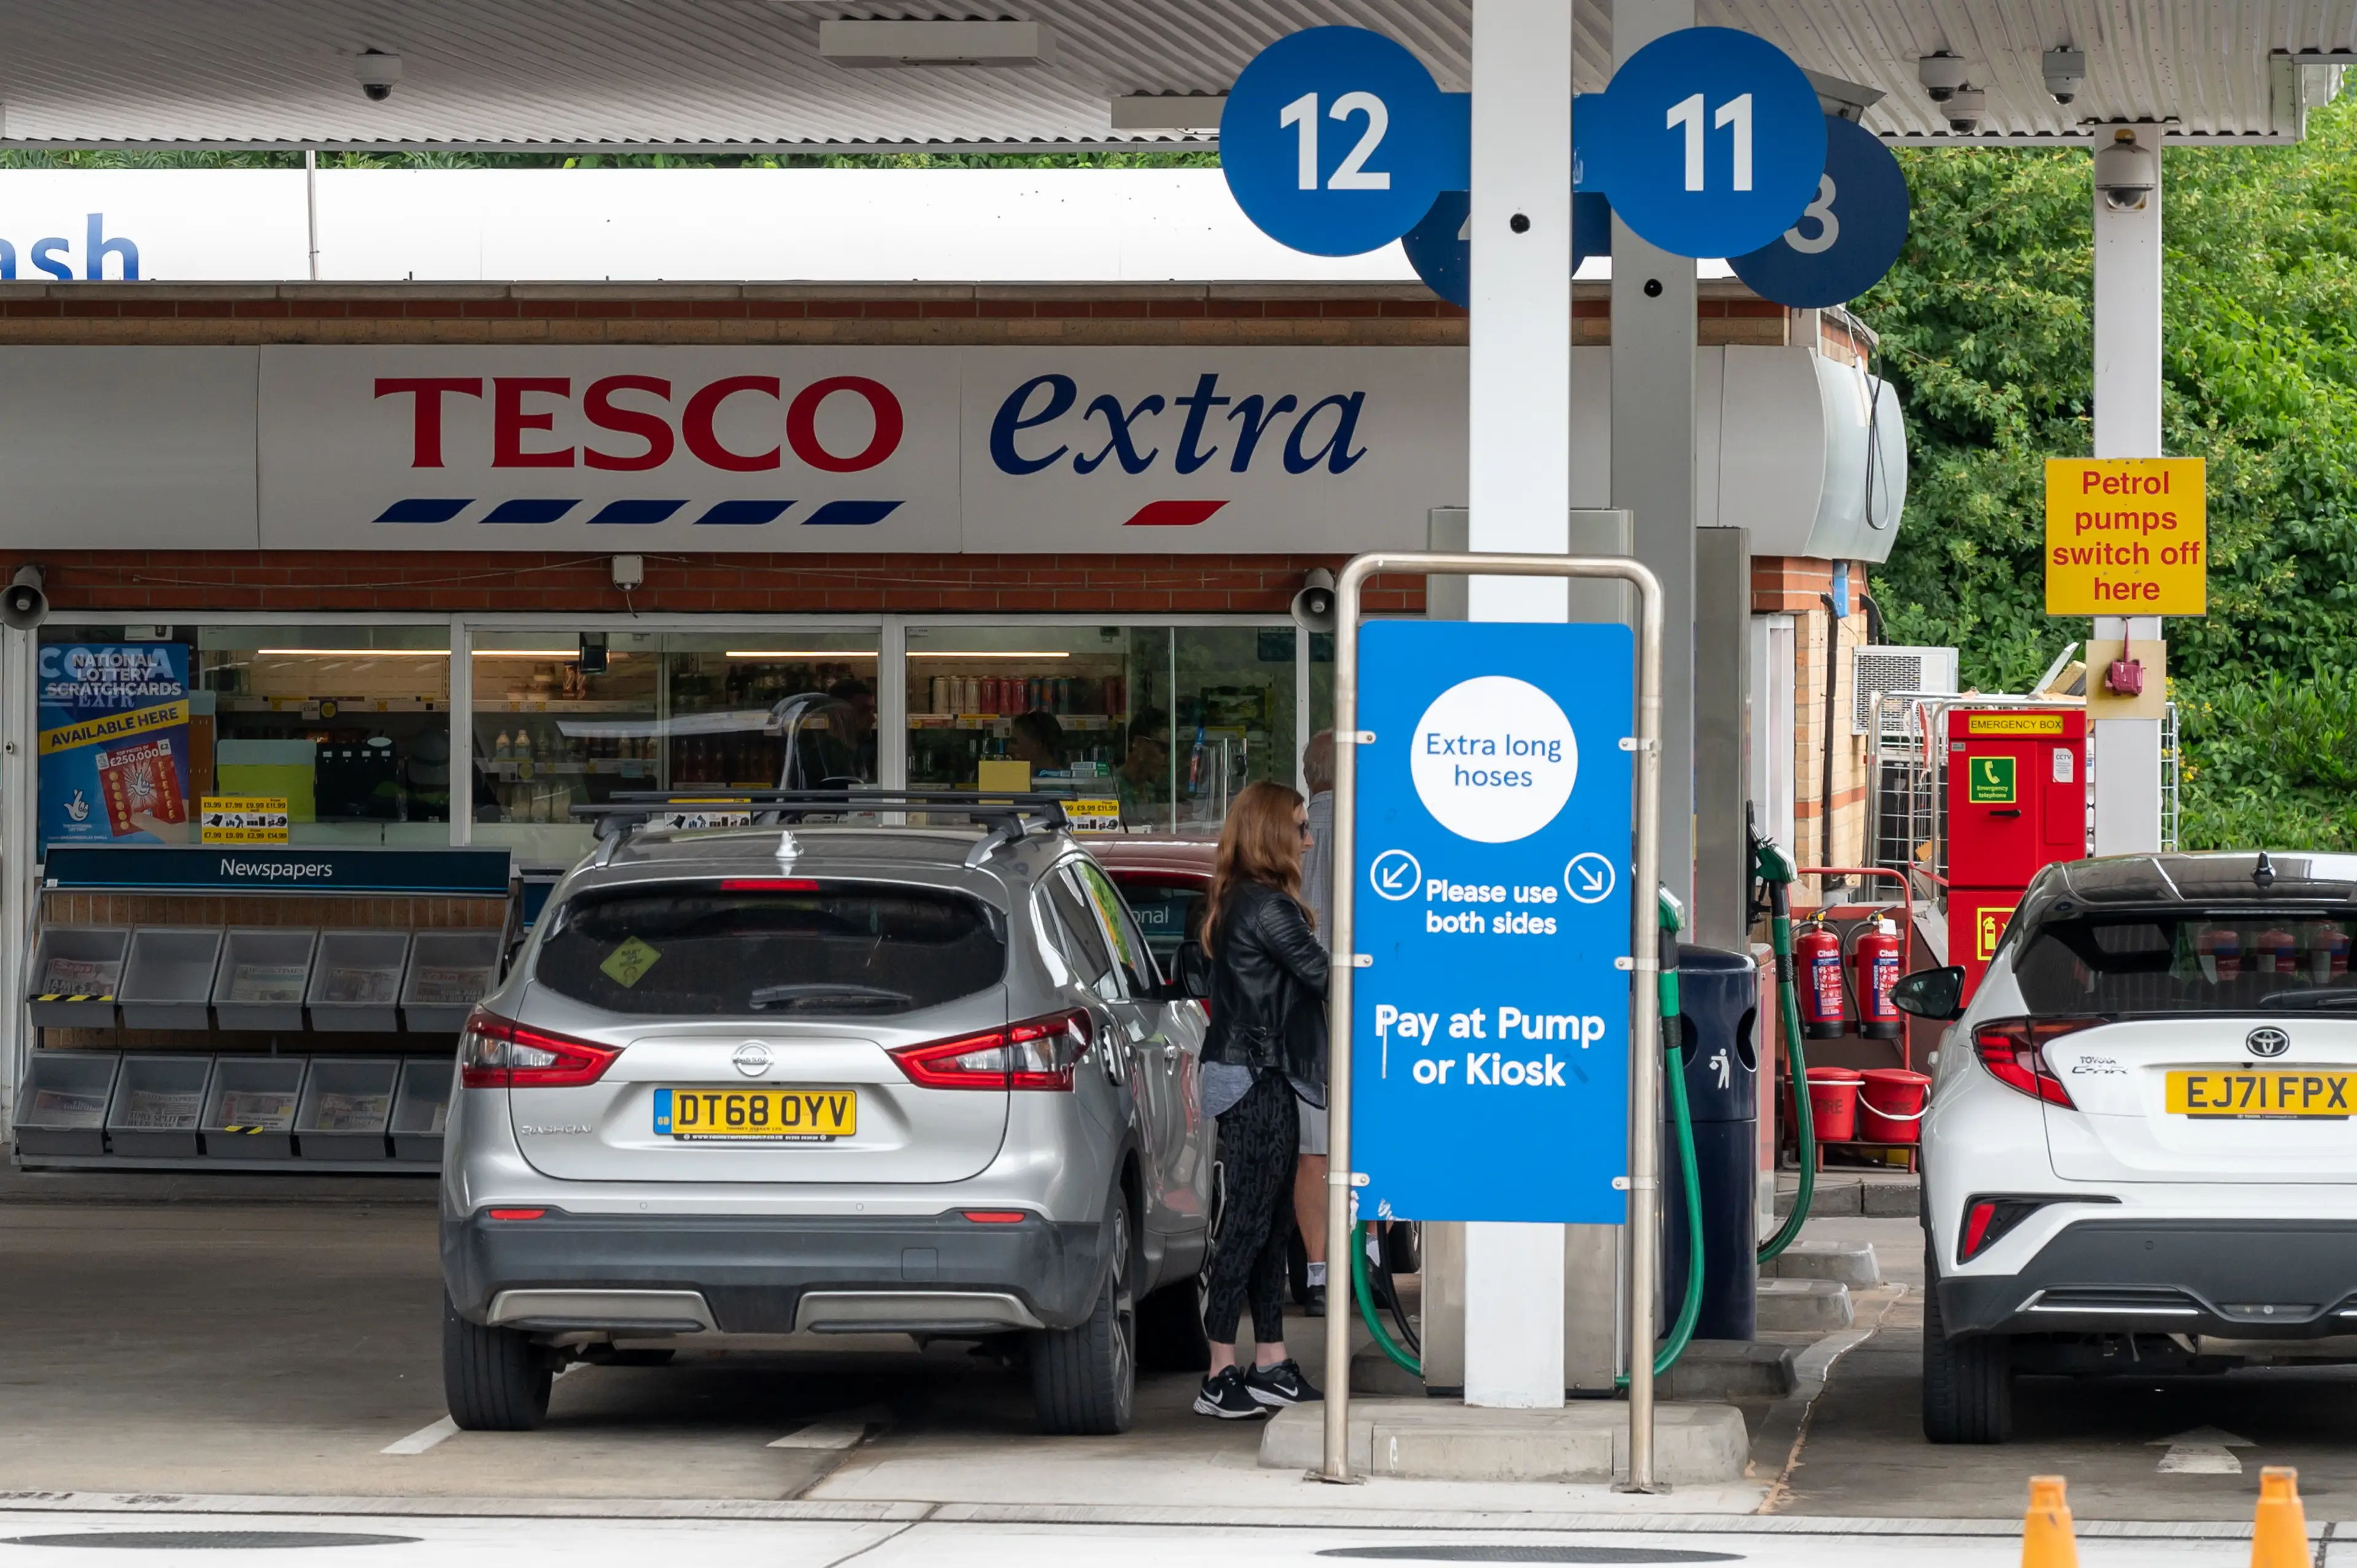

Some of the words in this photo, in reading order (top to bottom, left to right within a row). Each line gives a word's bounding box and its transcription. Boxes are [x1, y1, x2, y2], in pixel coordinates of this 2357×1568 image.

[1280, 91, 1391, 191] 12
[1666, 93, 1754, 191] 11
[1783, 173, 1839, 253] 3
[374, 374, 904, 473] TESCO
[989, 373, 1368, 475] extra
[2083, 471, 2169, 495] Petrol
[2075, 511, 2178, 536] pumps
[2053, 541, 2150, 565] switch
[2160, 541, 2200, 565] off
[2094, 577, 2160, 600] here
[72, 653, 158, 667] NATIONAL
[77, 668, 153, 682] LOTTERY
[47, 682, 182, 696] SCRATCHCARDS
[51, 716, 136, 747] AVAILABLE
[137, 707, 179, 727] HERE
[1970, 720, 2037, 729] EMERGENCY
[2040, 720, 2062, 729] BOX
[1426, 733, 1496, 755] Extra
[1506, 734, 1562, 763] long
[1455, 765, 1533, 787] hoses
[220, 859, 333, 879] Newspapers
[1426, 879, 1506, 903] Please
[1513, 886, 1558, 904] use
[1426, 910, 1485, 933] both
[1492, 911, 1557, 935] sides
[1375, 1004, 1439, 1046] Pay
[1449, 1007, 1486, 1038] at
[1498, 1006, 1606, 1049] Pump
[1412, 1058, 1456, 1085] or
[1466, 1052, 1566, 1087] Kiosk
[2080, 1056, 2116, 1064] TOYOTA
[2187, 1076, 2267, 1108] EJ71
[2278, 1076, 2348, 1108] FPX
[679, 1095, 769, 1127] DT68
[781, 1095, 848, 1127] OYV
[521, 1124, 593, 1136] QASHQAI
